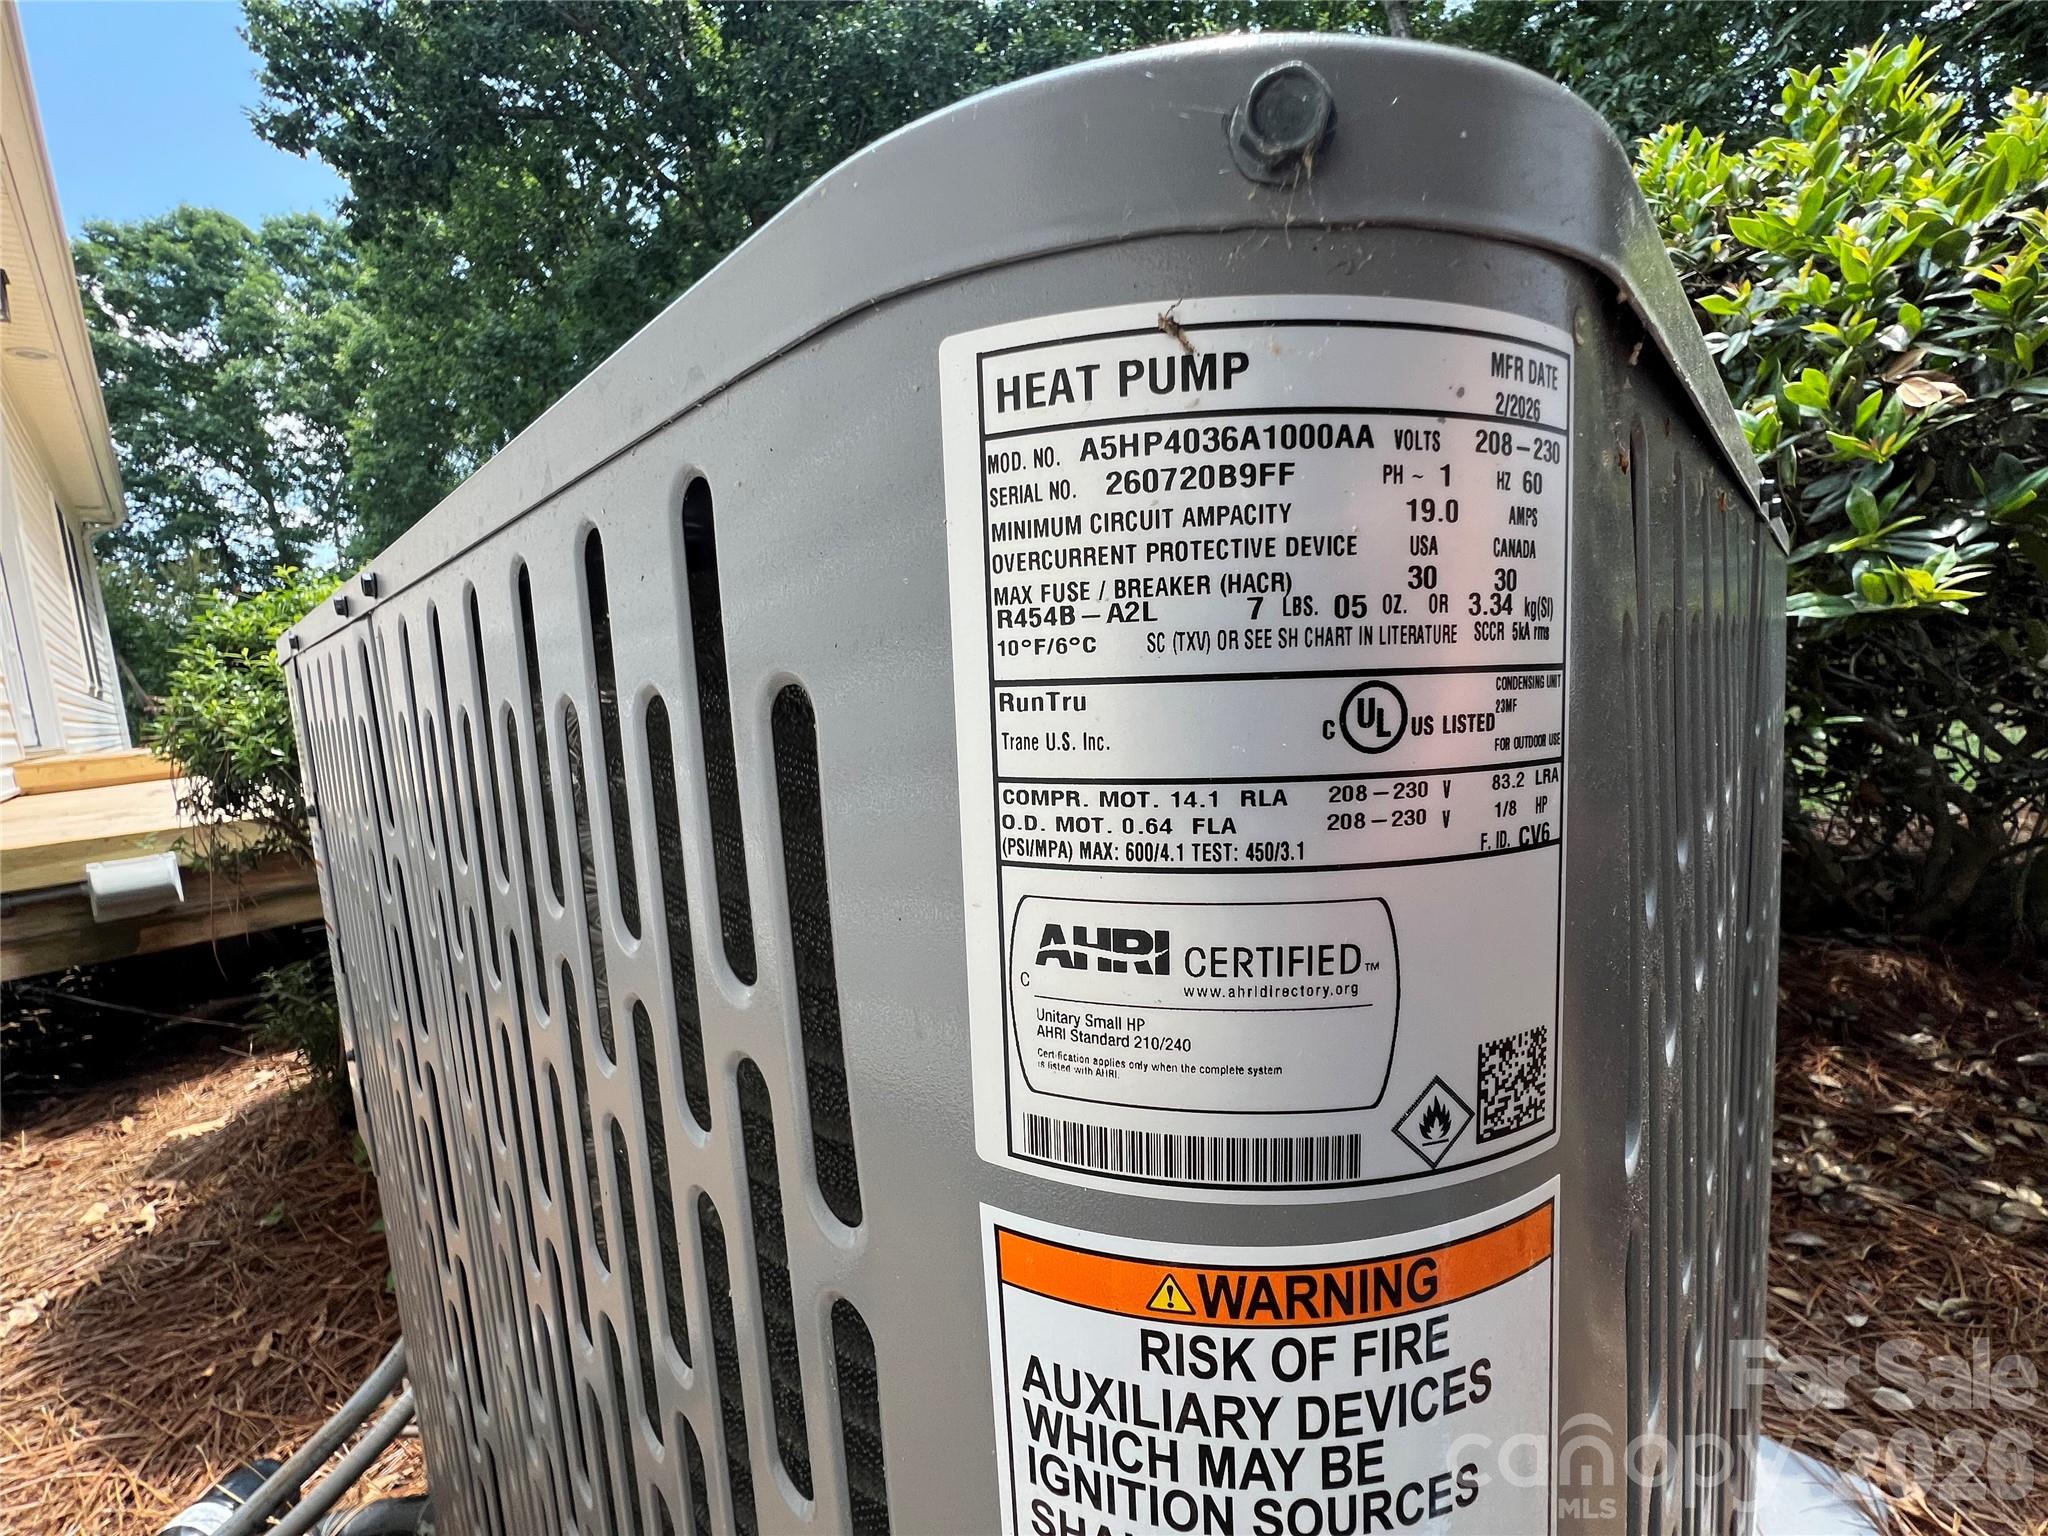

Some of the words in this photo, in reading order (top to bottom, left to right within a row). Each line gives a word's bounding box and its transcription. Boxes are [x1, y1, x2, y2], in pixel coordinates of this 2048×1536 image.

[997, 364, 1100, 413] HEAT
[1119, 352, 1249, 397] PUMP
[1491, 352, 1523, 382] MFR
[1529, 362, 1558, 391] DATE
[1496, 392, 1540, 422] 2/2026
[988, 455, 1026, 475] MOD.
[1034, 447, 1060, 468] NO.
[1080, 424, 1374, 462] A5HP4036A1000AA
[1394, 429, 1440, 452] VOLTS
[990, 481, 1043, 508] SERIAL
[1050, 479, 1076, 500] NO.
[1106, 463, 1295, 496] 260720B9FF
[1383, 464, 1402, 484] PH
[1440, 464, 1451, 486] 1
[1497, 471, 1511, 490] HZ
[1523, 472, 1542, 495] 60
[992, 515, 1082, 542] MINIMUM
[1090, 508, 1173, 533] CIRCUIT
[1182, 503, 1292, 527] AMPACITY
[1406, 499, 1459, 523] 19.0
[1509, 506, 1538, 528] AMPS
[992, 544, 1137, 574] OVERCURRENT
[1147, 537, 1276, 563] PROTECTIVE
[1286, 535, 1357, 558] DEVICE
[1410, 536, 1438, 556] USA
[1494, 538, 1536, 559] CANADA
[994, 586, 1032, 606] MAX
[1042, 581, 1090, 604] FUSE
[1115, 575, 1210, 599] BREAKER
[1220, 572, 1292, 598] (HACR)
[1408, 566, 1437, 589] 30
[1494, 568, 1517, 591] 30
[1247, 597, 1263, 620] 7
[1283, 595, 1318, 617] LBS.
[1334, 594, 1367, 618] 05
[1382, 594, 1407, 614] OZ.
[1428, 594, 1448, 613] OR
[1468, 593, 1513, 616] 3.34
[1146, 632, 1165, 653] SC
[1173, 631, 1210, 655] (TXV)
[1217, 630, 1239, 650] OR
[1245, 628, 1272, 648] SEE
[1278, 627, 1298, 648] SH
[1304, 626, 1353, 647] CHART
[1359, 626, 1373, 646] IN
[1379, 624, 1458, 645] LITERATURE
[1474, 621, 1505, 641] SCCR
[1512, 621, 1531, 640] 5kA
[999, 692, 1087, 712] RunTru
[1495, 675, 1544, 691] CONDENSING
[1546, 674, 1561, 689] UNIT
[1411, 715, 1434, 737] US
[1442, 713, 1495, 734] LISTED
[1495, 699, 1517, 713] 23MF
[1002, 732, 1039, 751] Trane
[1045, 732, 1076, 751] U.S.
[1083, 732, 1110, 751] Inc.
[1494, 737, 1510, 751] FOR
[1513, 734, 1546, 750] OUTDOOR
[1549, 732, 1561, 746] USE
[1002, 789, 1089, 807] COMPR.
[1099, 790, 1159, 808] MOT.
[1170, 790, 1218, 808] 14.1
[1240, 789, 1288, 808] RLA
[1443, 780, 1451, 799] V
[1492, 772, 1525, 791] 83.2
[1535, 767, 1559, 786] LRA
[1002, 814, 1046, 832] O.D.
[1055, 816, 1112, 834] MOT.
[1122, 817, 1173, 835] 0.64
[1192, 817, 1237, 835] FLA
[1442, 810, 1451, 829] V
[1494, 801, 1517, 818] 1/8
[1535, 795, 1548, 814] HP
[1002, 837, 1073, 862] (PSI/MPA)
[1079, 841, 1119, 861] MAX:
[1125, 842, 1184, 863] 600/4.1
[1192, 842, 1238, 862] TEST:
[1246, 841, 1305, 862] 450/3.1
[1496, 830, 1510, 849] ID.
[1519, 822, 1550, 847] CV6
[1035, 923, 1170, 976] AHRI
[1184, 944, 1362, 978] CERTIFIED
[1036, 1008, 1080, 1028] Unitary
[1085, 1014, 1122, 1030] Small
[1127, 1018, 1145, 1032] HP
[1037, 1025, 1066, 1041] AHRI
[1070, 1029, 1130, 1048] Standard
[1133, 1036, 1192, 1052] 210/240
[1047, 1061, 1071, 1073] listed
[1073, 1066, 1093, 1077] with
[1092, 1057, 1126, 1069] applies
[1129, 1061, 1148, 1073] only
[1151, 1063, 1178, 1073] when
[1181, 1063, 1196, 1074] the
[1199, 1064, 1245, 1076] complete
[1247, 1065, 1283, 1076] system
[1197, 1258, 1437, 1321] WARNING
[1140, 1329, 1256, 1382] RISK
[1271, 1336, 1337, 1383] OF
[1354, 1313, 1450, 1376] FIRE
[1022, 1354, 1283, 1441] AUXILIARY
[1298, 1357, 1493, 1441] DEVICES
[1023, 1397, 1179, 1483] WHICH
[1199, 1442, 1305, 1491] MAY
[1322, 1439, 1385, 1490] BE
[1028, 1446, 1236, 1535] IGNITION
[1252, 1462, 1480, 1536] SOURCES
